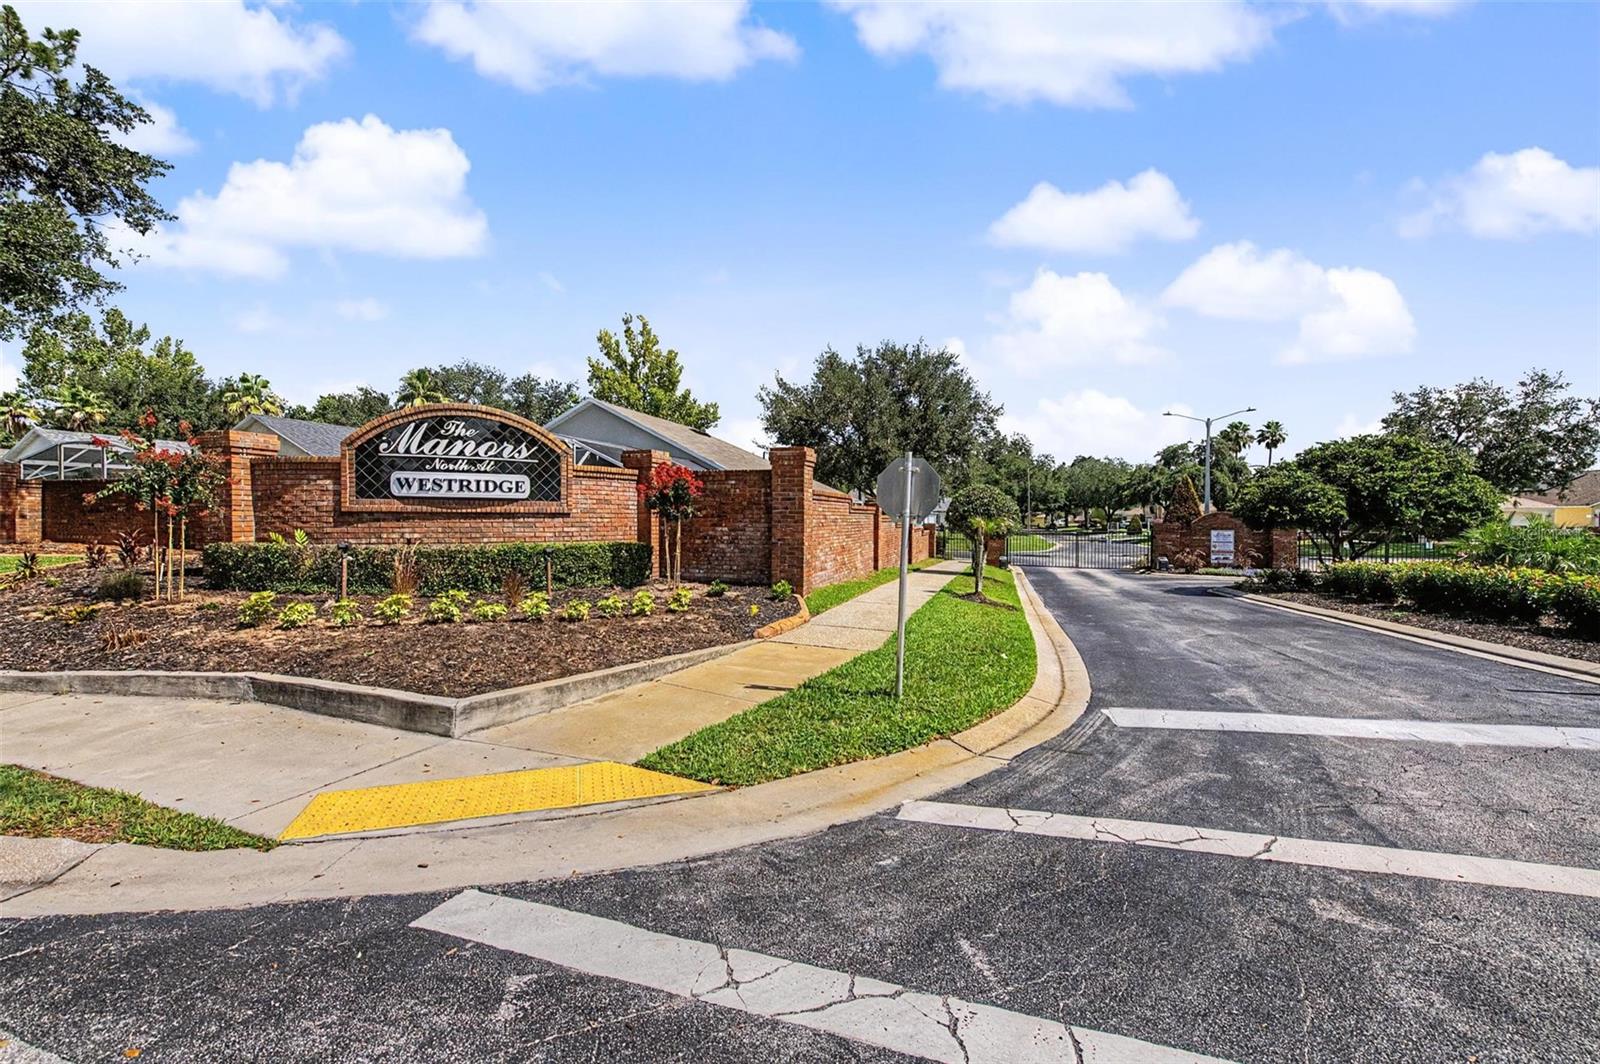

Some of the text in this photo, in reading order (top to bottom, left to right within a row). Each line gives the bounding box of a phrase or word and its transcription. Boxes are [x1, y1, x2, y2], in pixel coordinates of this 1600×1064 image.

[441, 420, 479, 437] The
[379, 422, 538, 459] Manors
[426, 458, 496, 472] North At
[395, 477, 526, 494] WESTRIDGE
